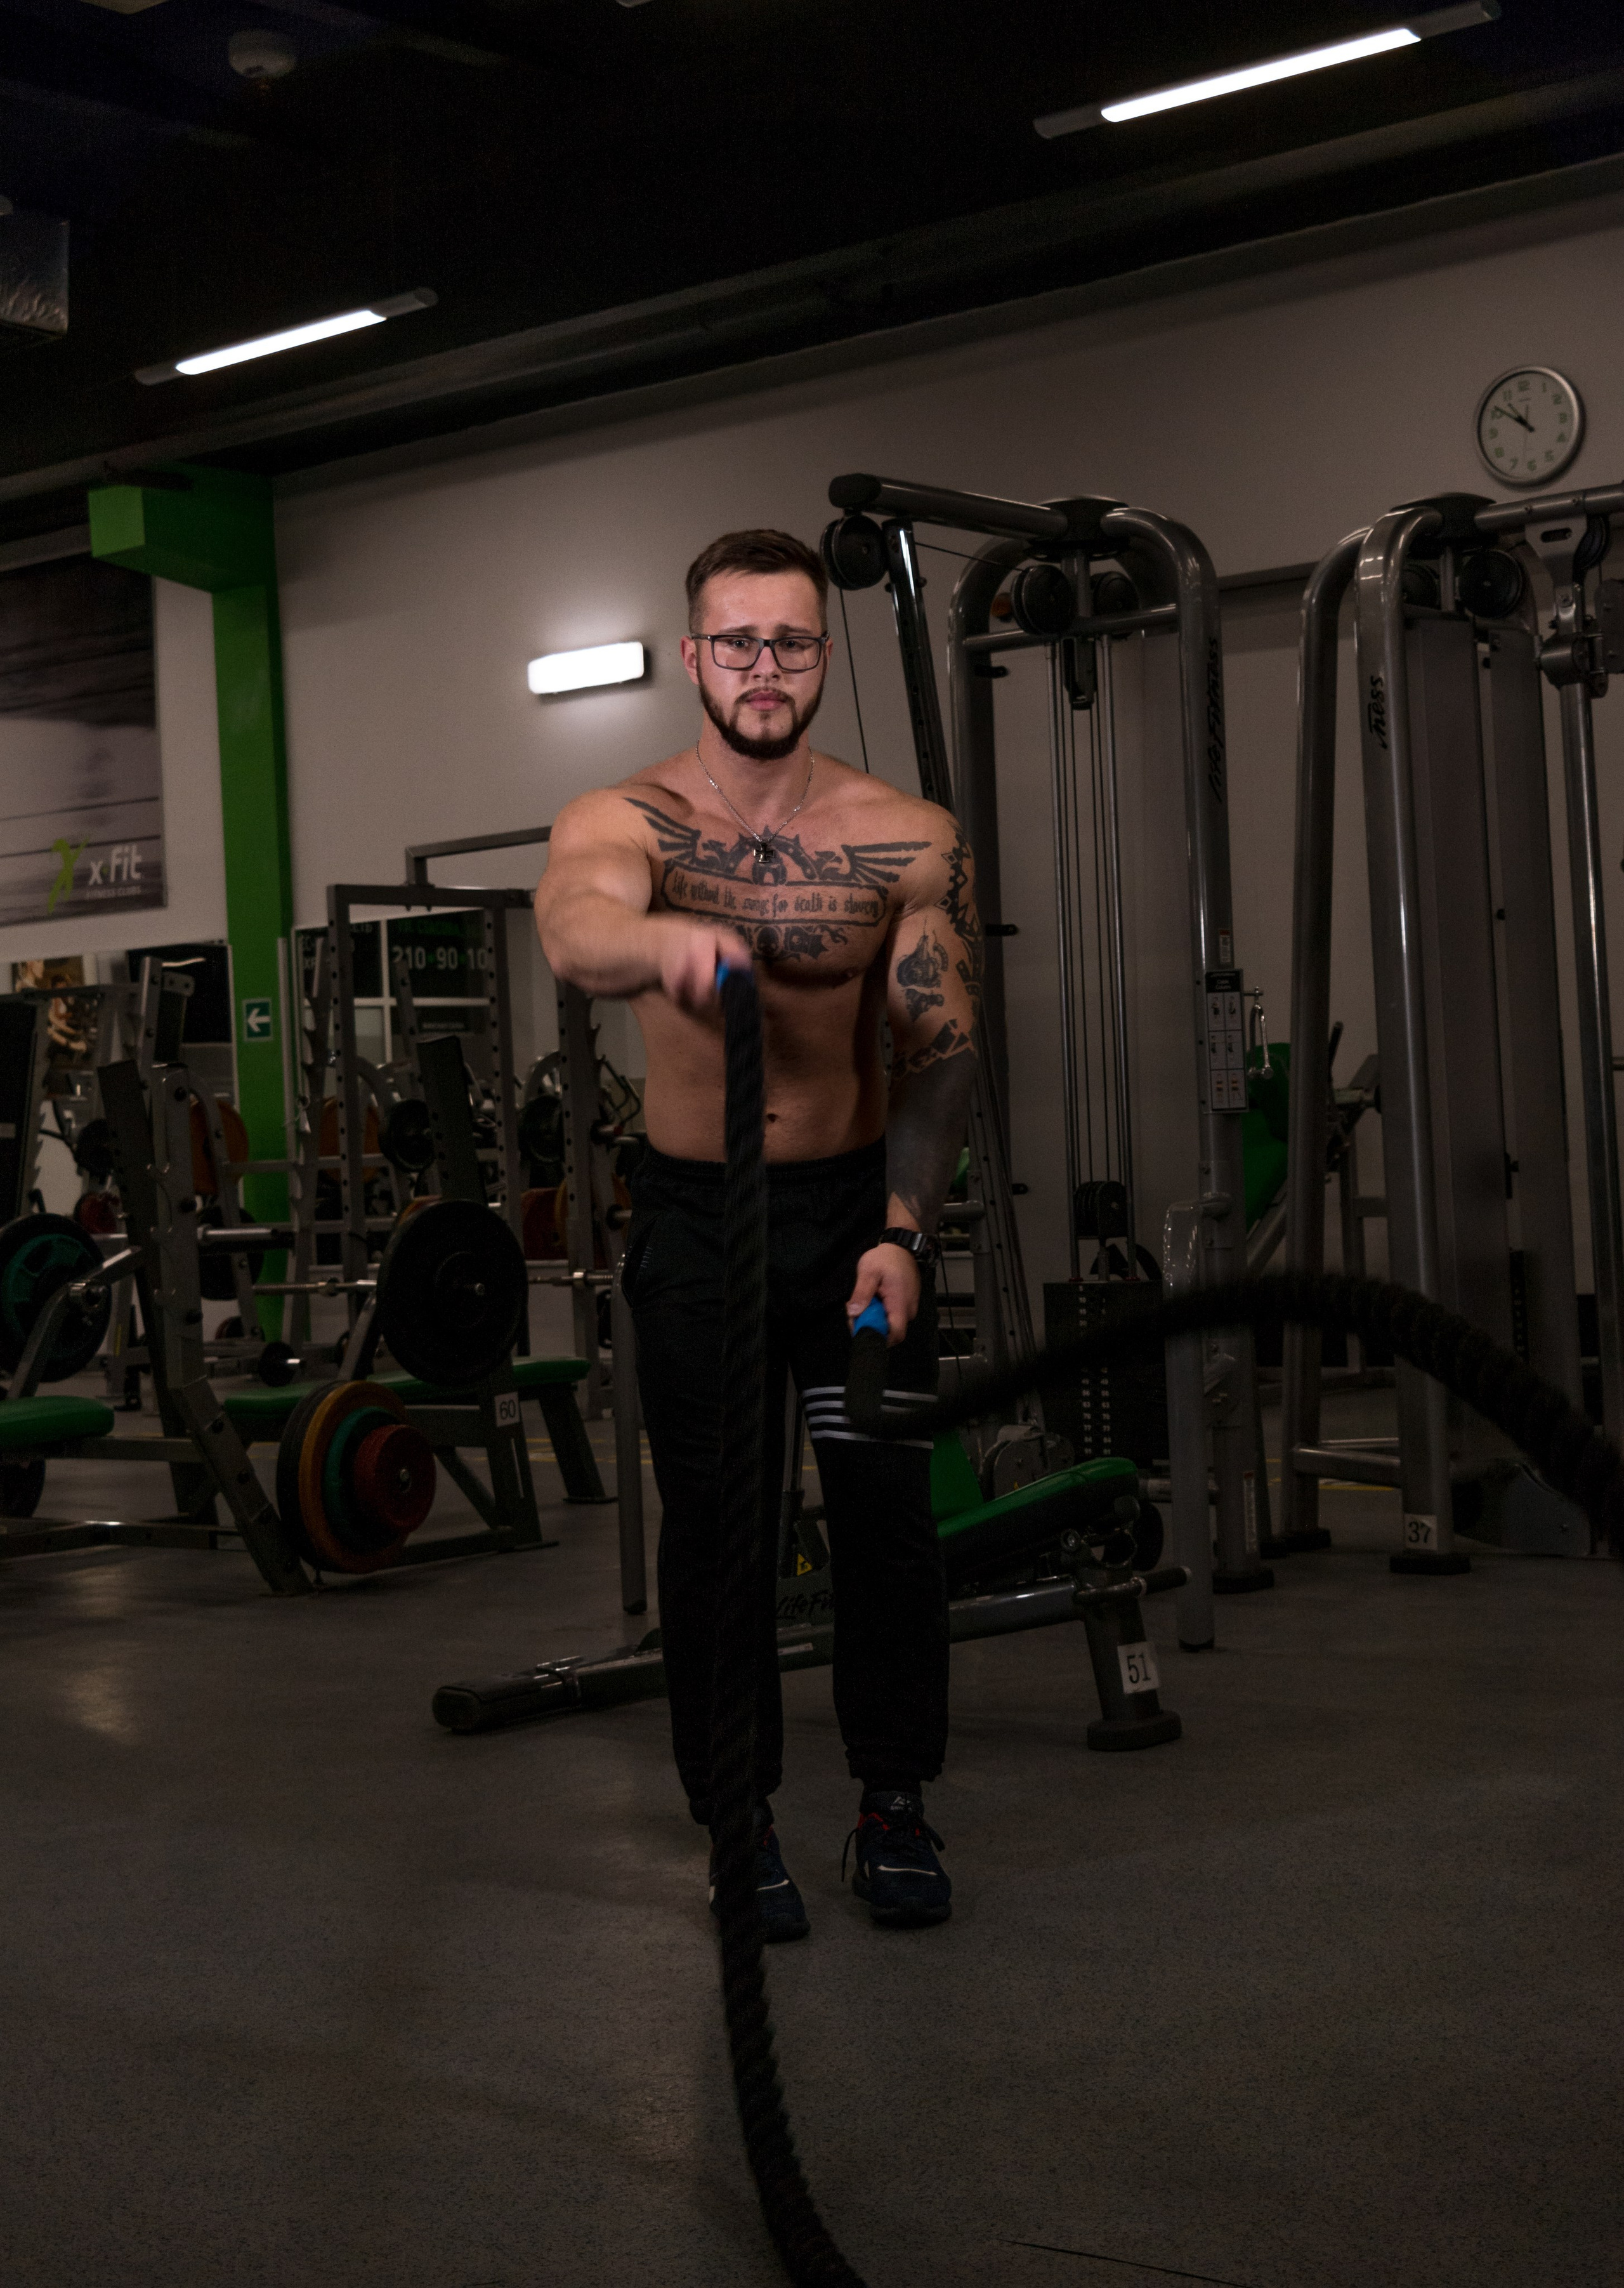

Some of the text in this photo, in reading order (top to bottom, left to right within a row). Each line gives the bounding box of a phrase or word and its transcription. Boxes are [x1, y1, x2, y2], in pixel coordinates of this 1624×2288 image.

[1552, 393, 1562, 405] 2
[1544, 449, 1554, 462] 5
[1509, 457, 1518, 471] 7
[1526, 459, 1537, 471] 6
[828, 895, 837, 912] is
[500, 1399, 516, 1420] 60
[1409, 1521, 1431, 1543] 37
[1127, 1652, 1151, 1683] 51
